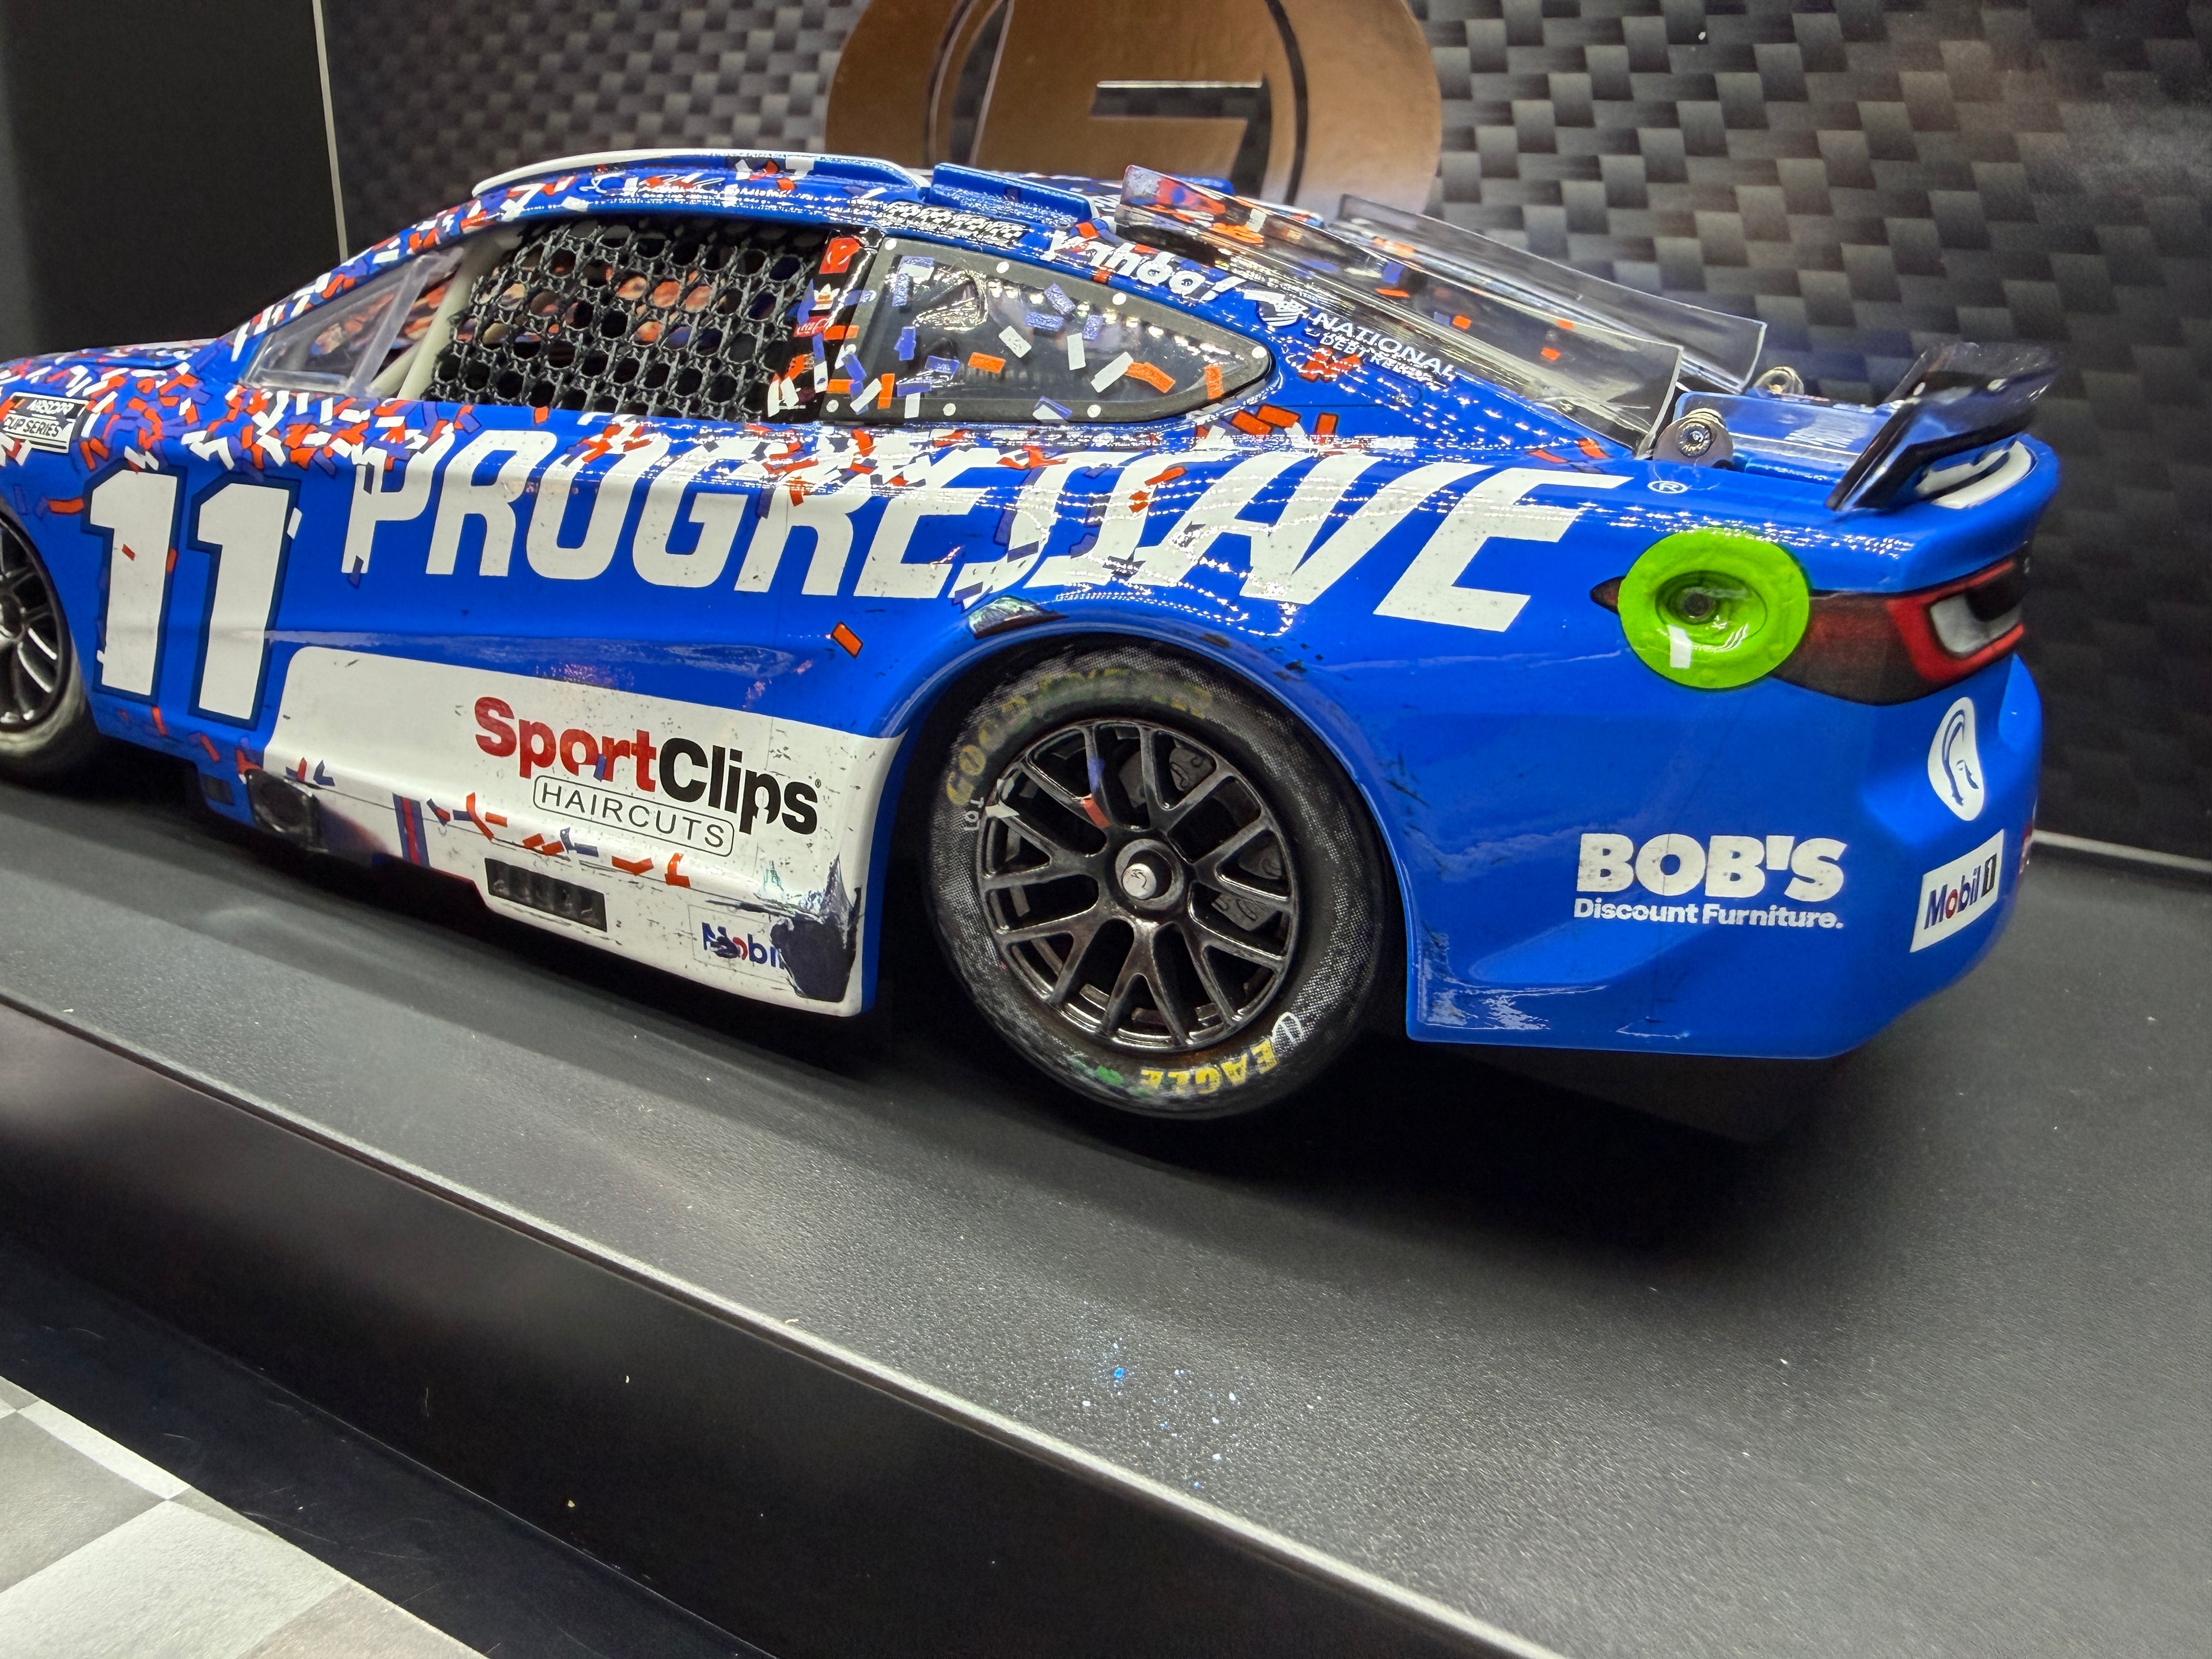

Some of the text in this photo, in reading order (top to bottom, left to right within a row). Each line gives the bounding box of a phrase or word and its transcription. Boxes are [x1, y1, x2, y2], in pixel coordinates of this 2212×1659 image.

[1310, 312, 1456, 381] NATIONAL
[89, 468, 291, 721] 11
[540, 782, 725, 849] HAIRCUTS
[1576, 833, 1847, 902] BOB'S
[1924, 853, 1998, 930] Mobil 1
[1574, 897, 1844, 929] Discount Furniture.
